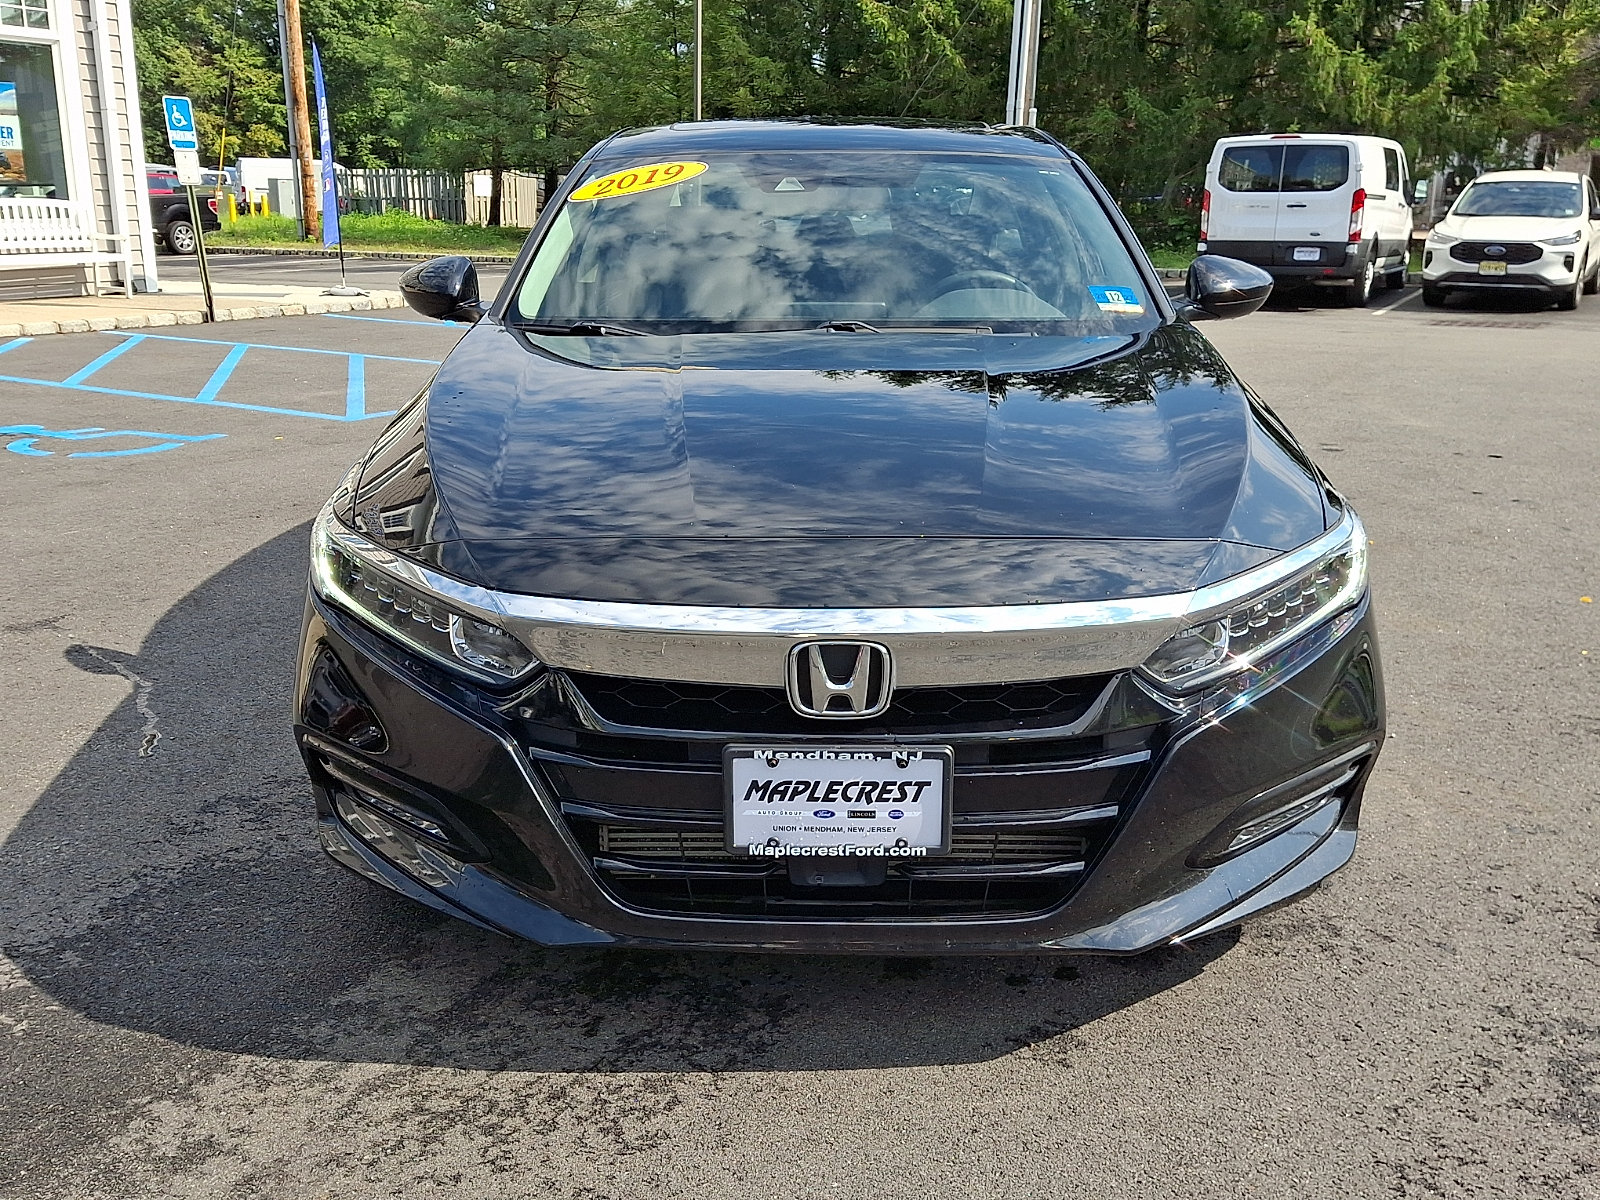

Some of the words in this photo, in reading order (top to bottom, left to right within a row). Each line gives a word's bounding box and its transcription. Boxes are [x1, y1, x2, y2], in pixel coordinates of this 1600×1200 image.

[593, 165, 685, 196] 2019
[1108, 292, 1123, 302] 12
[753, 750, 882, 762] Mendham,
[891, 751, 923, 762] NJ
[743, 779, 932, 805] MAPLECREST
[816, 810, 832, 818] Ford
[749, 843, 927, 858] MaplecrestFord.com
